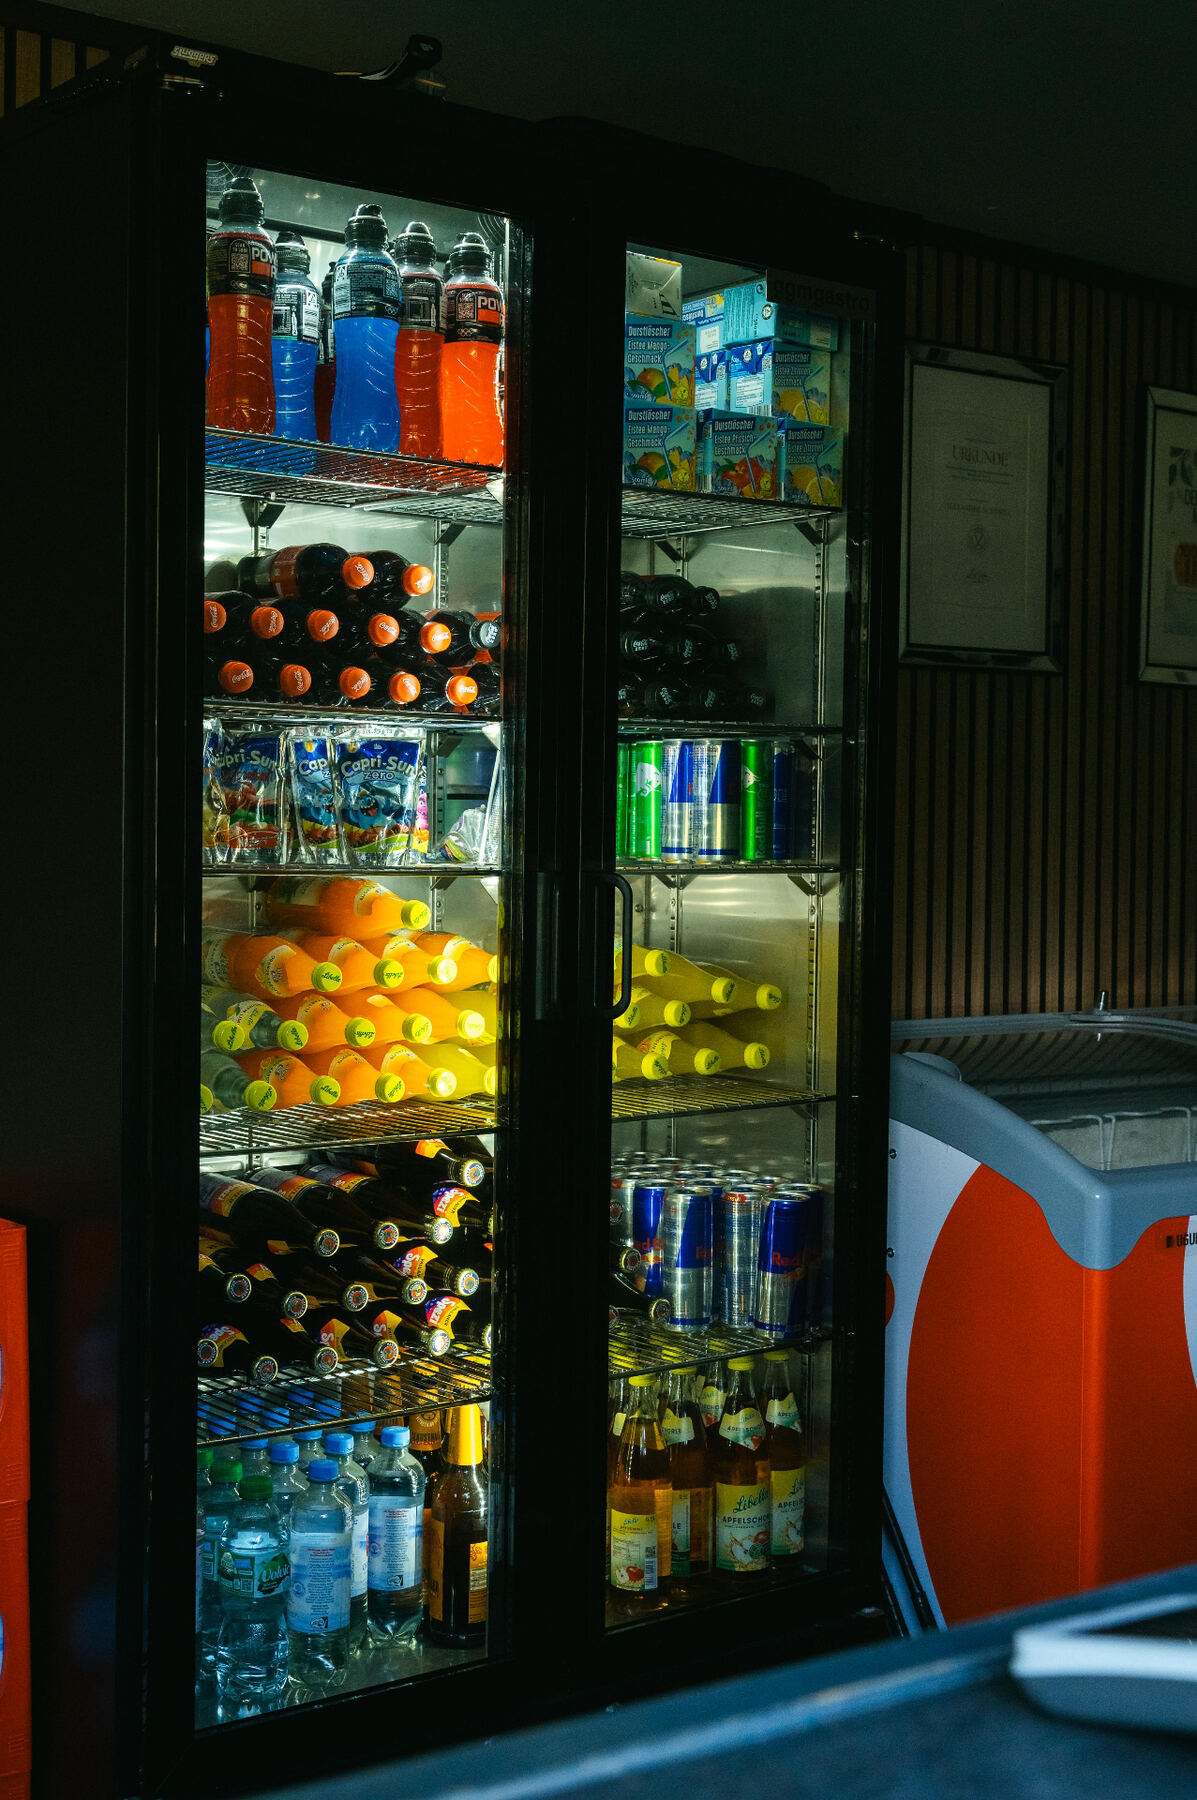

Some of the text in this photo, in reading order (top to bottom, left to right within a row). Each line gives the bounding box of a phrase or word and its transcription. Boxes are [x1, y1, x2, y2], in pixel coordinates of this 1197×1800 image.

[628, 325, 671, 337] Durstlöscher
[628, 341, 647, 350] Eistee
[628, 354, 662, 364] Geschmack
[628, 409, 671, 421] Durstlöscher
[714, 420, 754, 431] Durstlöscher
[628, 438, 663, 447] Geschmack
[952, 445, 1008, 466] URKUNDE
[341, 755, 417, 777] Capri-Sun
[364, 770, 395, 780] zero
[321, 971, 341, 983] Libelle
[321, 1085, 338, 1098] Libelle
[436, 1188, 465, 1213] Spezi
[429, 1297, 456, 1325] Spezi
